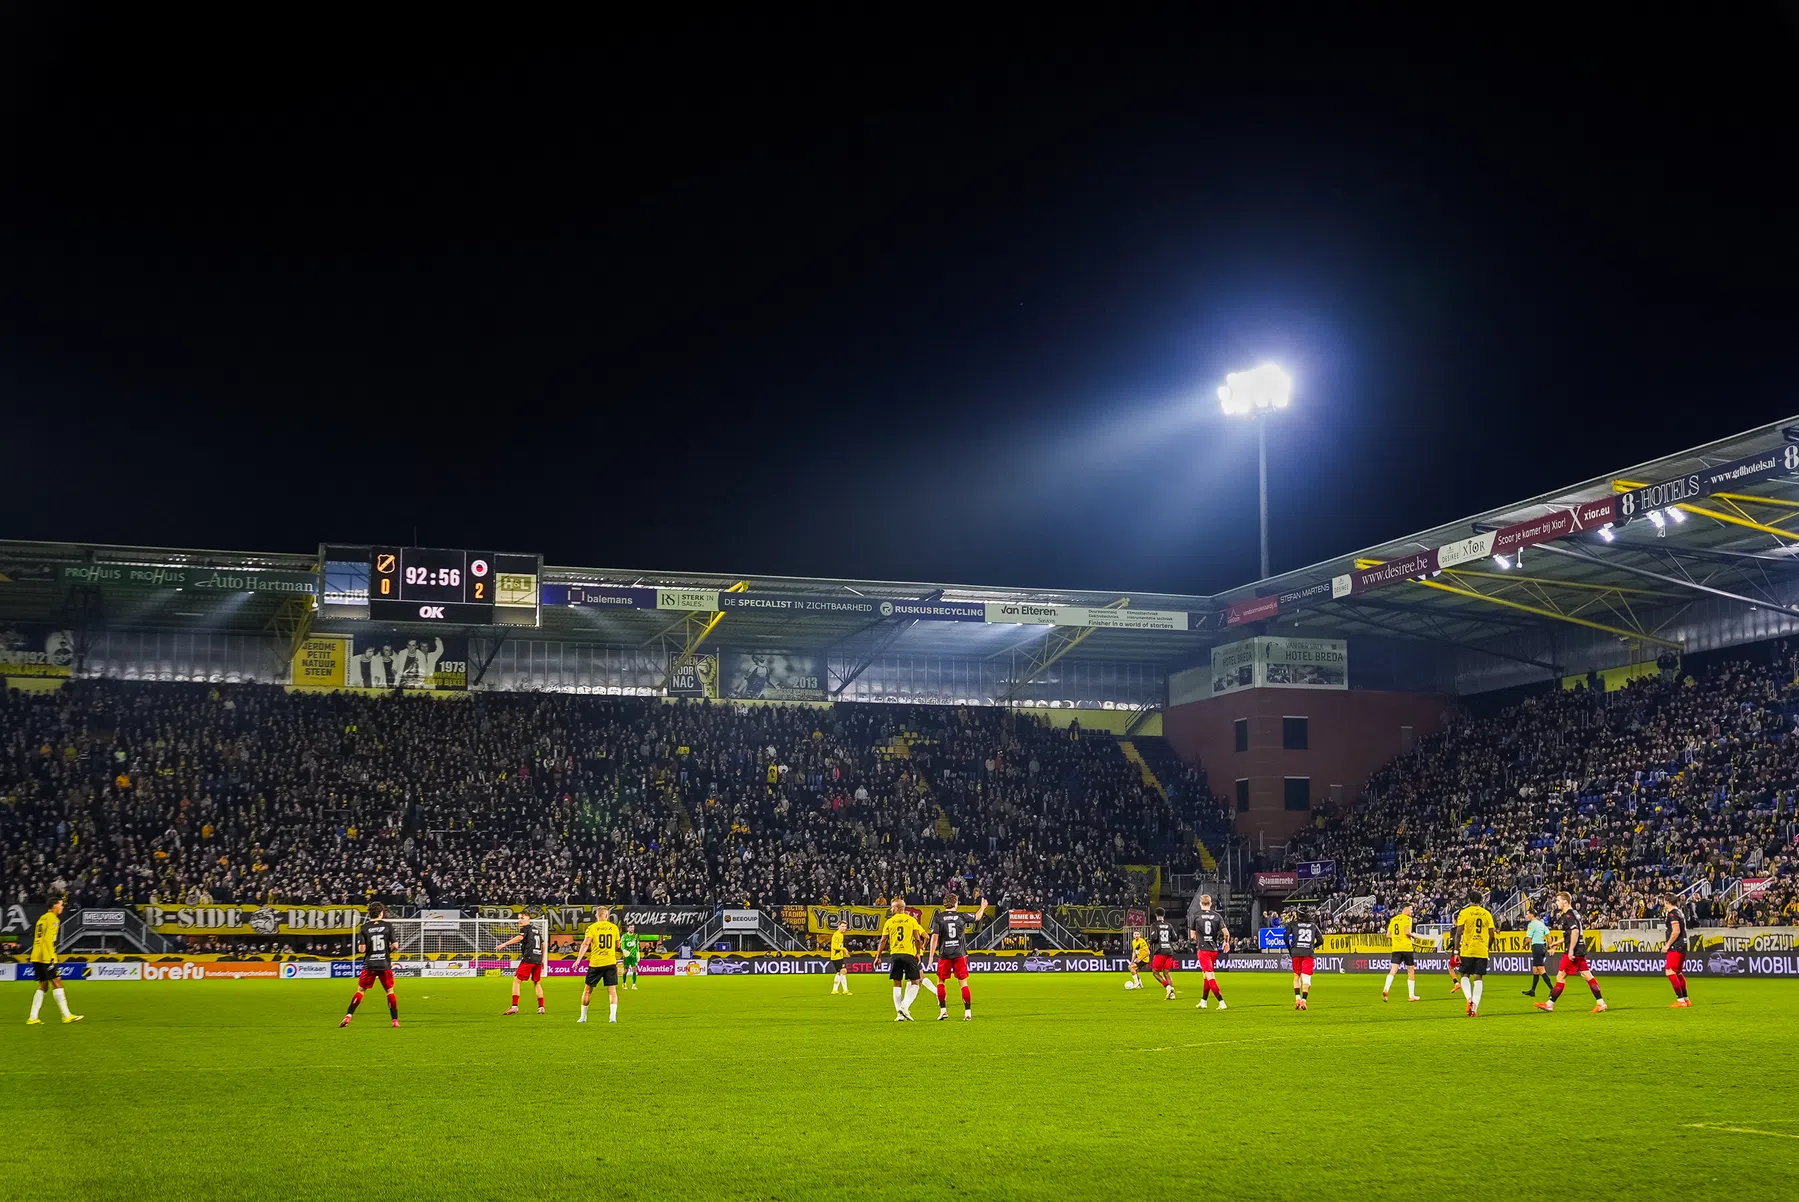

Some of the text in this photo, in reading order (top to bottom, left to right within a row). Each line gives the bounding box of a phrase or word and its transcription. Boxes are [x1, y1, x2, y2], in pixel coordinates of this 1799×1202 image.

[1621, 492, 1635, 516] 8
[1640, 475, 1700, 511] HOTELS
[1784, 445, 1799, 470] 8
[1583, 506, 1611, 522] xior.eu
[1498, 518, 1567, 546] Scoor je kamer bij Xior!
[405, 567, 461, 587] 92:56
[1361, 556, 1428, 586] www.desiree.be
[206, 571, 314, 593] Auto Hartman
[381, 578, 391, 595] 0
[474, 583, 484, 599] 2
[681, 593, 705, 601] STERK
[1280, 583, 1330, 604] STEFAN MARTENS
[586, 594, 633, 605] balemans
[724, 598, 873, 613] DE SPECIALIST IN ZICHTBAARHEID
[419, 606, 445, 619] OK
[1000, 604, 1019, 616] Van
[1088, 619, 1111, 627] Finisher
[307, 652, 332, 660] PETIT
[1285, 651, 1344, 662] HOTEL BREDA
[301, 660, 336, 669] NATUUR
[439, 661, 466, 673] 1973
[304, 668, 333, 677] STEEN
[672, 675, 694, 688] NAC
[792, 676, 818, 688] 2013
[144, 907, 361, 930] B-SIDE BRED
[623, 911, 667, 926] ASOCIALE
[812, 907, 880, 931] Yellow
[1067, 907, 1127, 931] NAC
[947, 922, 957, 938] 5
[1204, 921, 1211, 935] 6
[1394, 923, 1400, 936] 8
[1475, 918, 1483, 934] 9
[896, 926, 905, 942] 3
[1298, 929, 1312, 942] 23
[371, 934, 385, 951] 15
[598, 933, 613, 950] 90
[1723, 934, 1794, 952] NIET OPZIJ!
[637, 965, 674, 973] Vakantie?
[754, 961, 831, 974] MOBILITY
[845, 962, 873, 972] ESTE
[993, 962, 1019, 971] 2026
[1264, 957, 1278, 969] 2026
[1313, 957, 1344, 971] OBILITY
